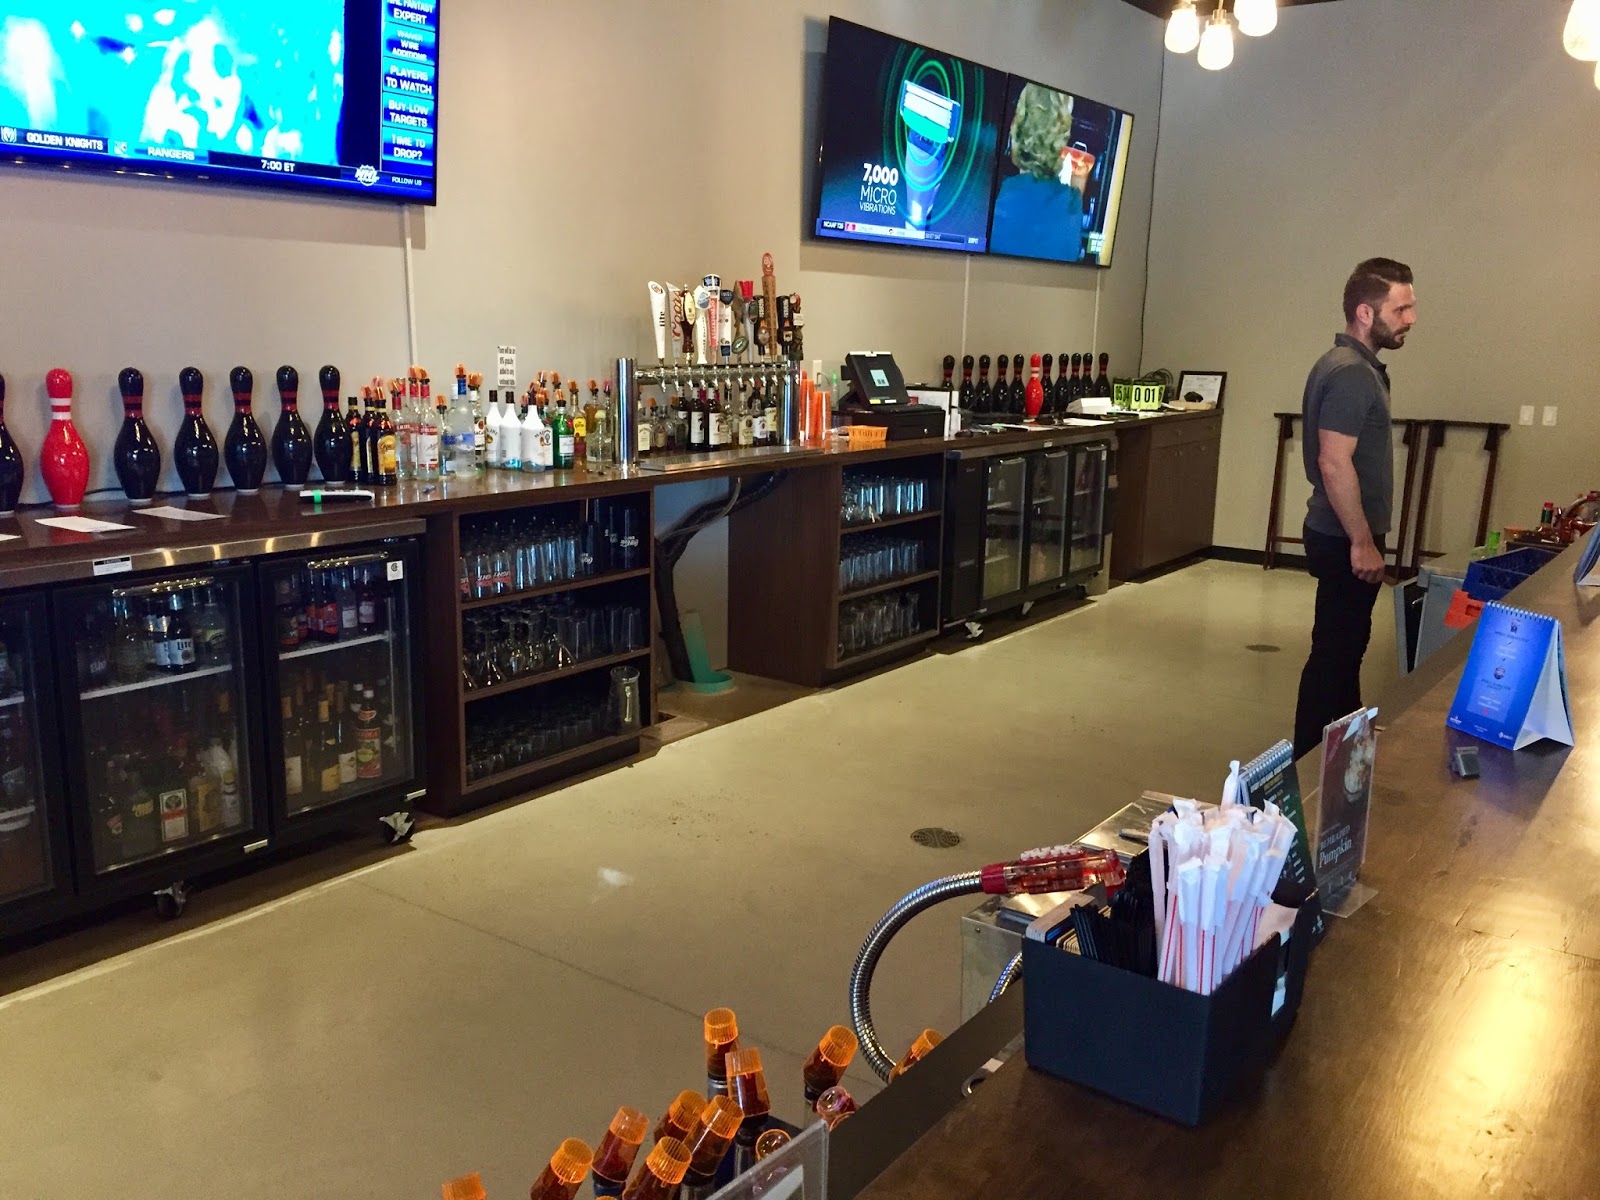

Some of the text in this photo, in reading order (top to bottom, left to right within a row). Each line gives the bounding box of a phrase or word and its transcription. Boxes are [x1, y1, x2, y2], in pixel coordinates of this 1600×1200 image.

[393, 7, 427, 24] EXPERT
[389, 64, 428, 81] PLAYERS
[386, 76, 432, 95] TO WATCH
[388, 99, 429, 115] BUY-LOW
[389, 112, 428, 127] TARGETS
[26, 132, 103, 150] GOLDEN KNIGHTS
[391, 134, 426, 148] TIME TO
[147, 146, 195, 160] RANGERS
[393, 146, 423, 160] DROP?
[261, 159, 295, 172] 7:00 ET
[391, 176, 413, 186] FOLLOW
[863, 163, 899, 187] 7,000
[860, 185, 896, 205] MICRO
[859, 202, 896, 215] VIBRATIONS
[1144, 387, 1155, 403] 01
[1319, 837, 1352, 869] Pumpkin
